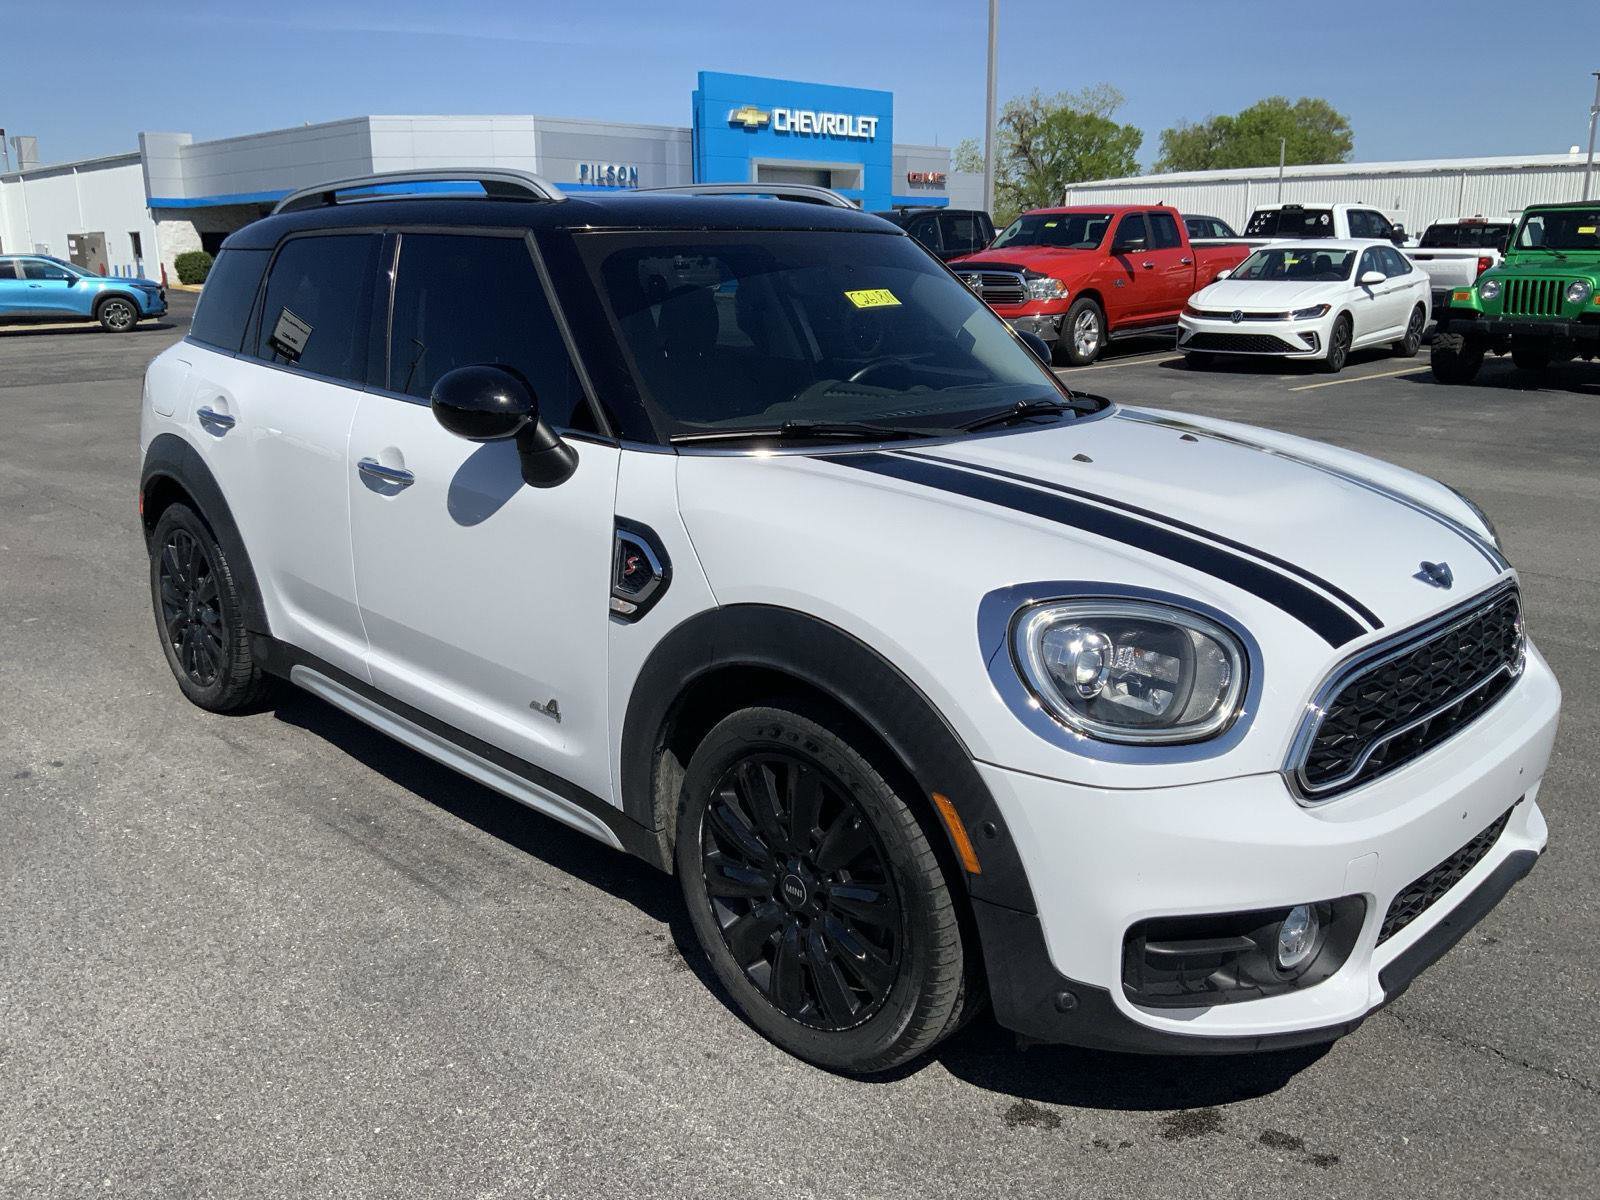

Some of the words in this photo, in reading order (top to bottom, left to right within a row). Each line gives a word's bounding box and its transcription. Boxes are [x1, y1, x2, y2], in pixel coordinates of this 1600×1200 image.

[773, 108, 878, 137] CHEVROLET
[579, 163, 639, 184] PILSON
[907, 171, 946, 184] GMC
[624, 556, 639, 575] S
[785, 883, 803, 898] MINI
